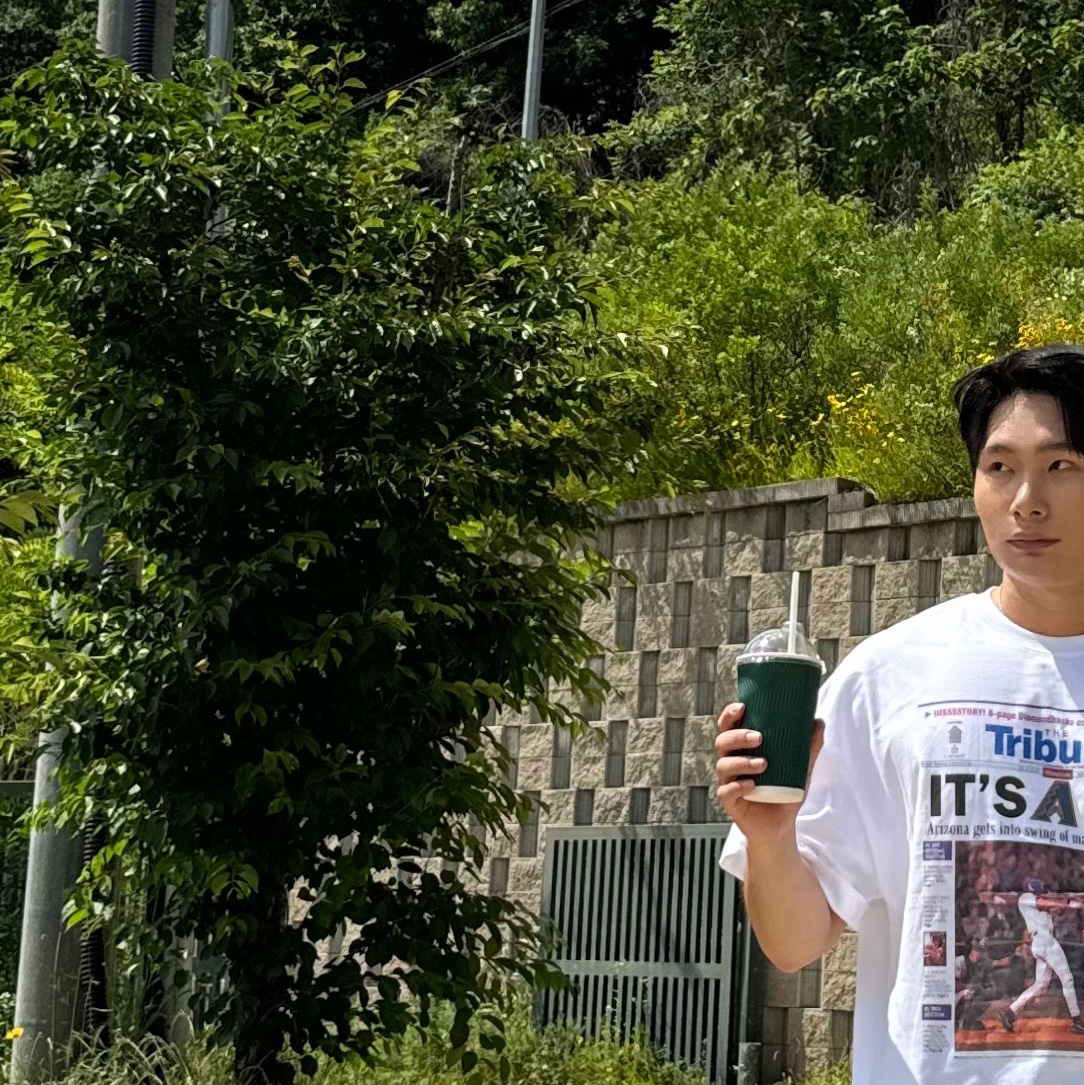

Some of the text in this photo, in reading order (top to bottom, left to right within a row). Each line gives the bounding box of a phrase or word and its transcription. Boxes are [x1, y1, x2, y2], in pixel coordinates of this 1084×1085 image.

[1045, 728, 1069, 738] THE
[927, 821, 970, 837] Arizona
[972, 823, 996, 839] gets
[999, 823, 1021, 836] into
[1023, 825, 1056, 843] swing
[1059, 829, 1070, 842] of
